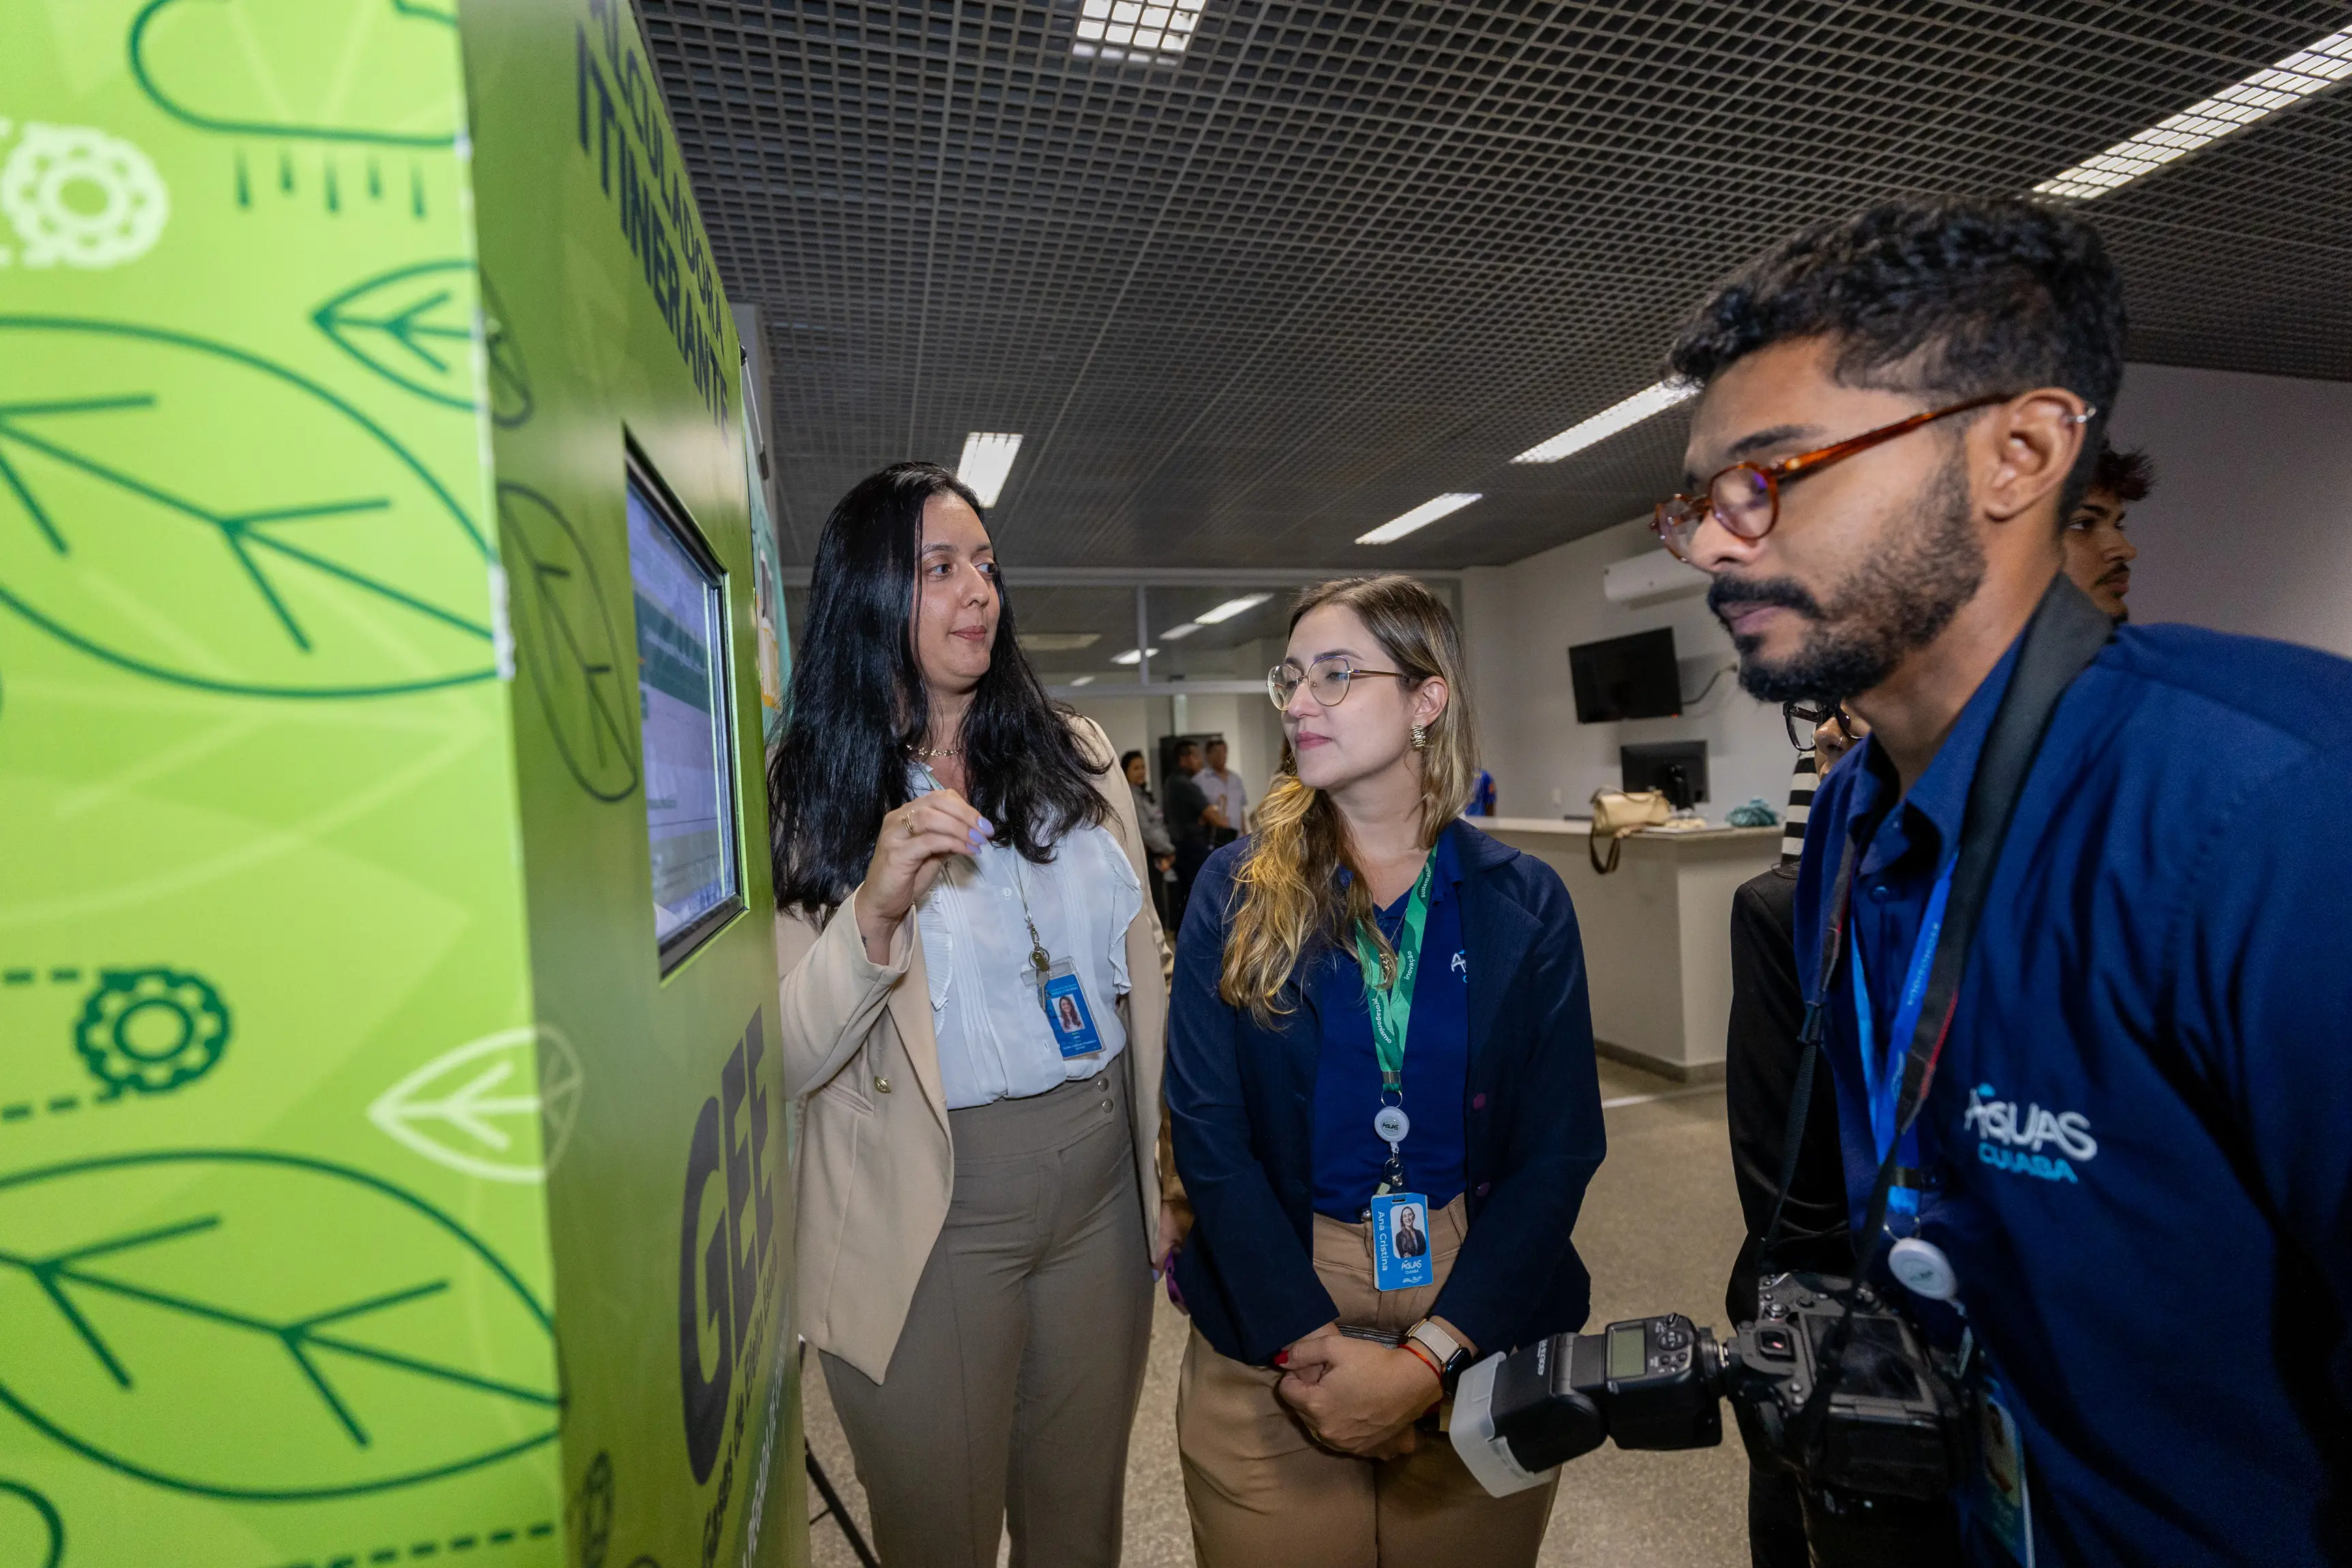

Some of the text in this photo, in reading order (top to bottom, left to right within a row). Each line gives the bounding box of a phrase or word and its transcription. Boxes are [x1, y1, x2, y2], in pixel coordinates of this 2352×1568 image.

[575, 19, 729, 450] ITINERANTE
[1404, 950, 1415, 980] inovação
[1372, 997, 1392, 1044] protagonismo
[679, 1002, 774, 1486] GEE
[1379, 1233, 1389, 1271] Cristina
